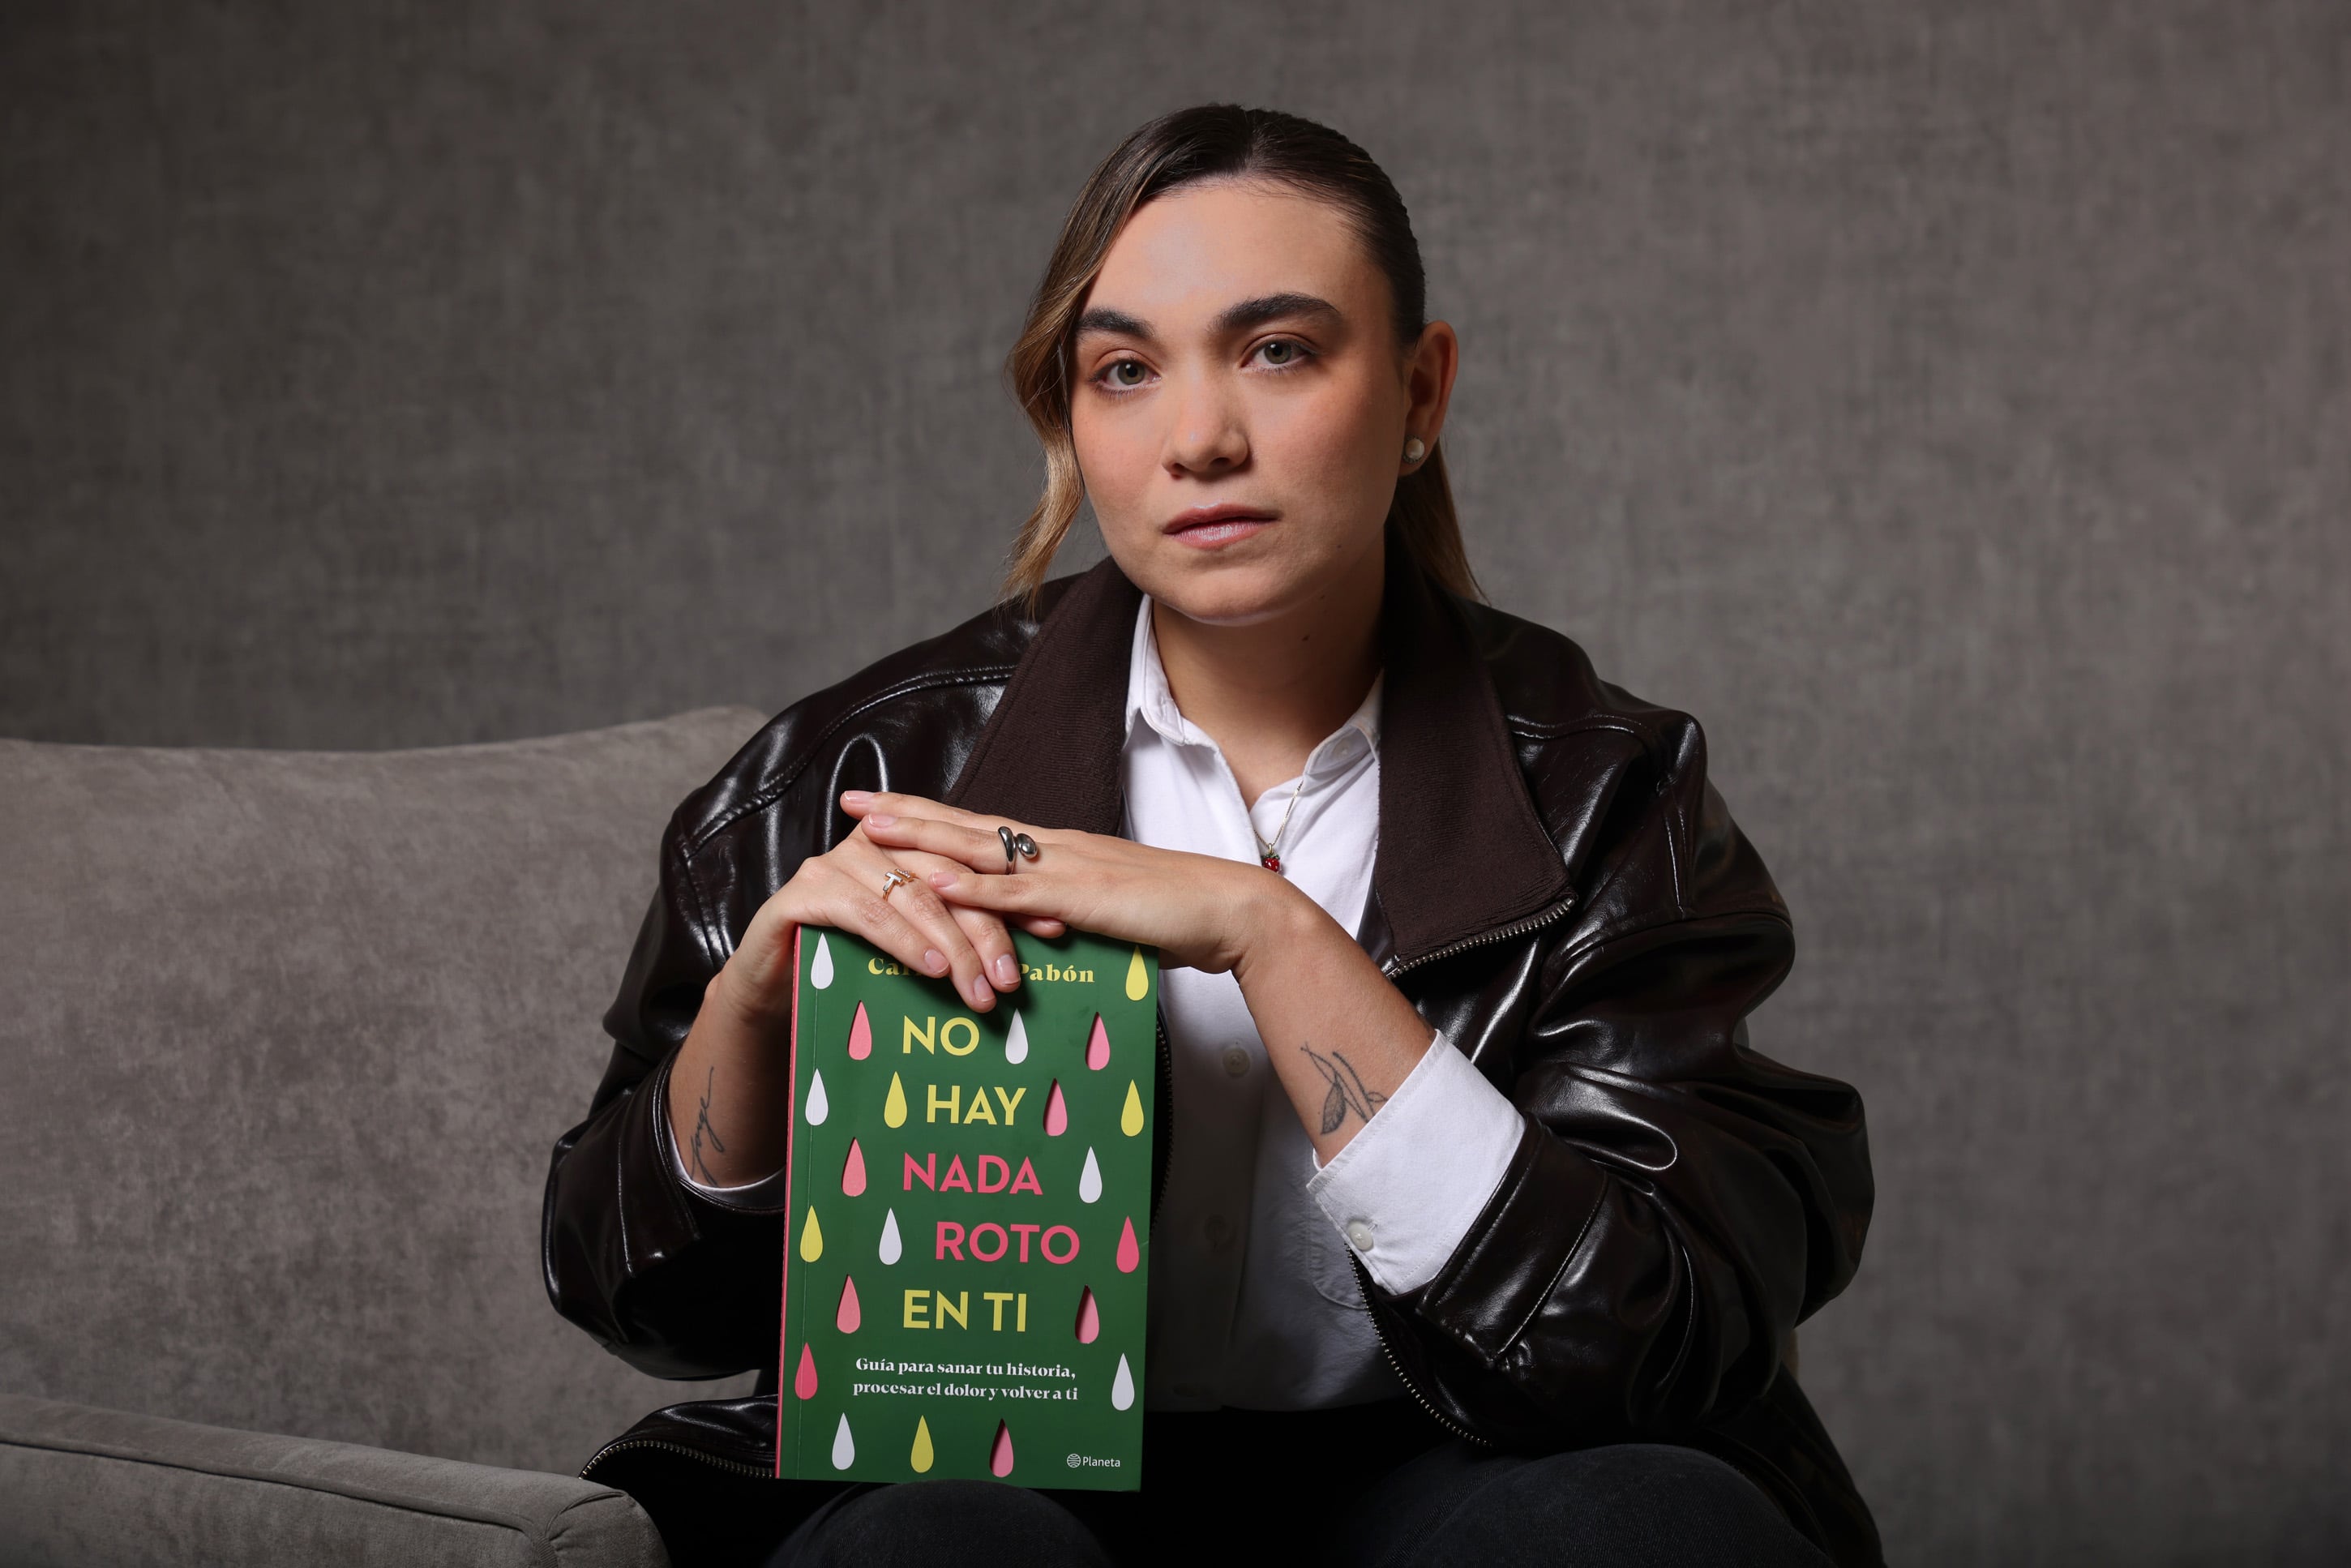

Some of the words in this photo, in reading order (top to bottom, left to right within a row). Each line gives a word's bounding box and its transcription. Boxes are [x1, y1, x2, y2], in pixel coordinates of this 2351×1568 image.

[902, 1015, 980, 1056] NO
[927, 1084, 1027, 1126] HAY
[902, 1152, 1043, 1196] NADA
[936, 1221, 1081, 1265] ROTO
[903, 1289, 969, 1330] EN
[983, 1292, 1027, 1332] TI
[855, 1357, 895, 1372] Guía
[898, 1362, 935, 1375] para
[936, 1364, 983, 1374] sanar
[986, 1364, 1003, 1375] tu
[1006, 1362, 1076, 1380] historia,
[853, 1383, 925, 1396] procesar
[927, 1382, 941, 1395] el
[944, 1383, 987, 1397] dolor
[988, 1388, 999, 1401] y
[1001, 1386, 1051, 1399] volver
[1052, 1390, 1062, 1400] a
[1065, 1387, 1078, 1400] ti
[1082, 1456, 1121, 1467] Planeta
